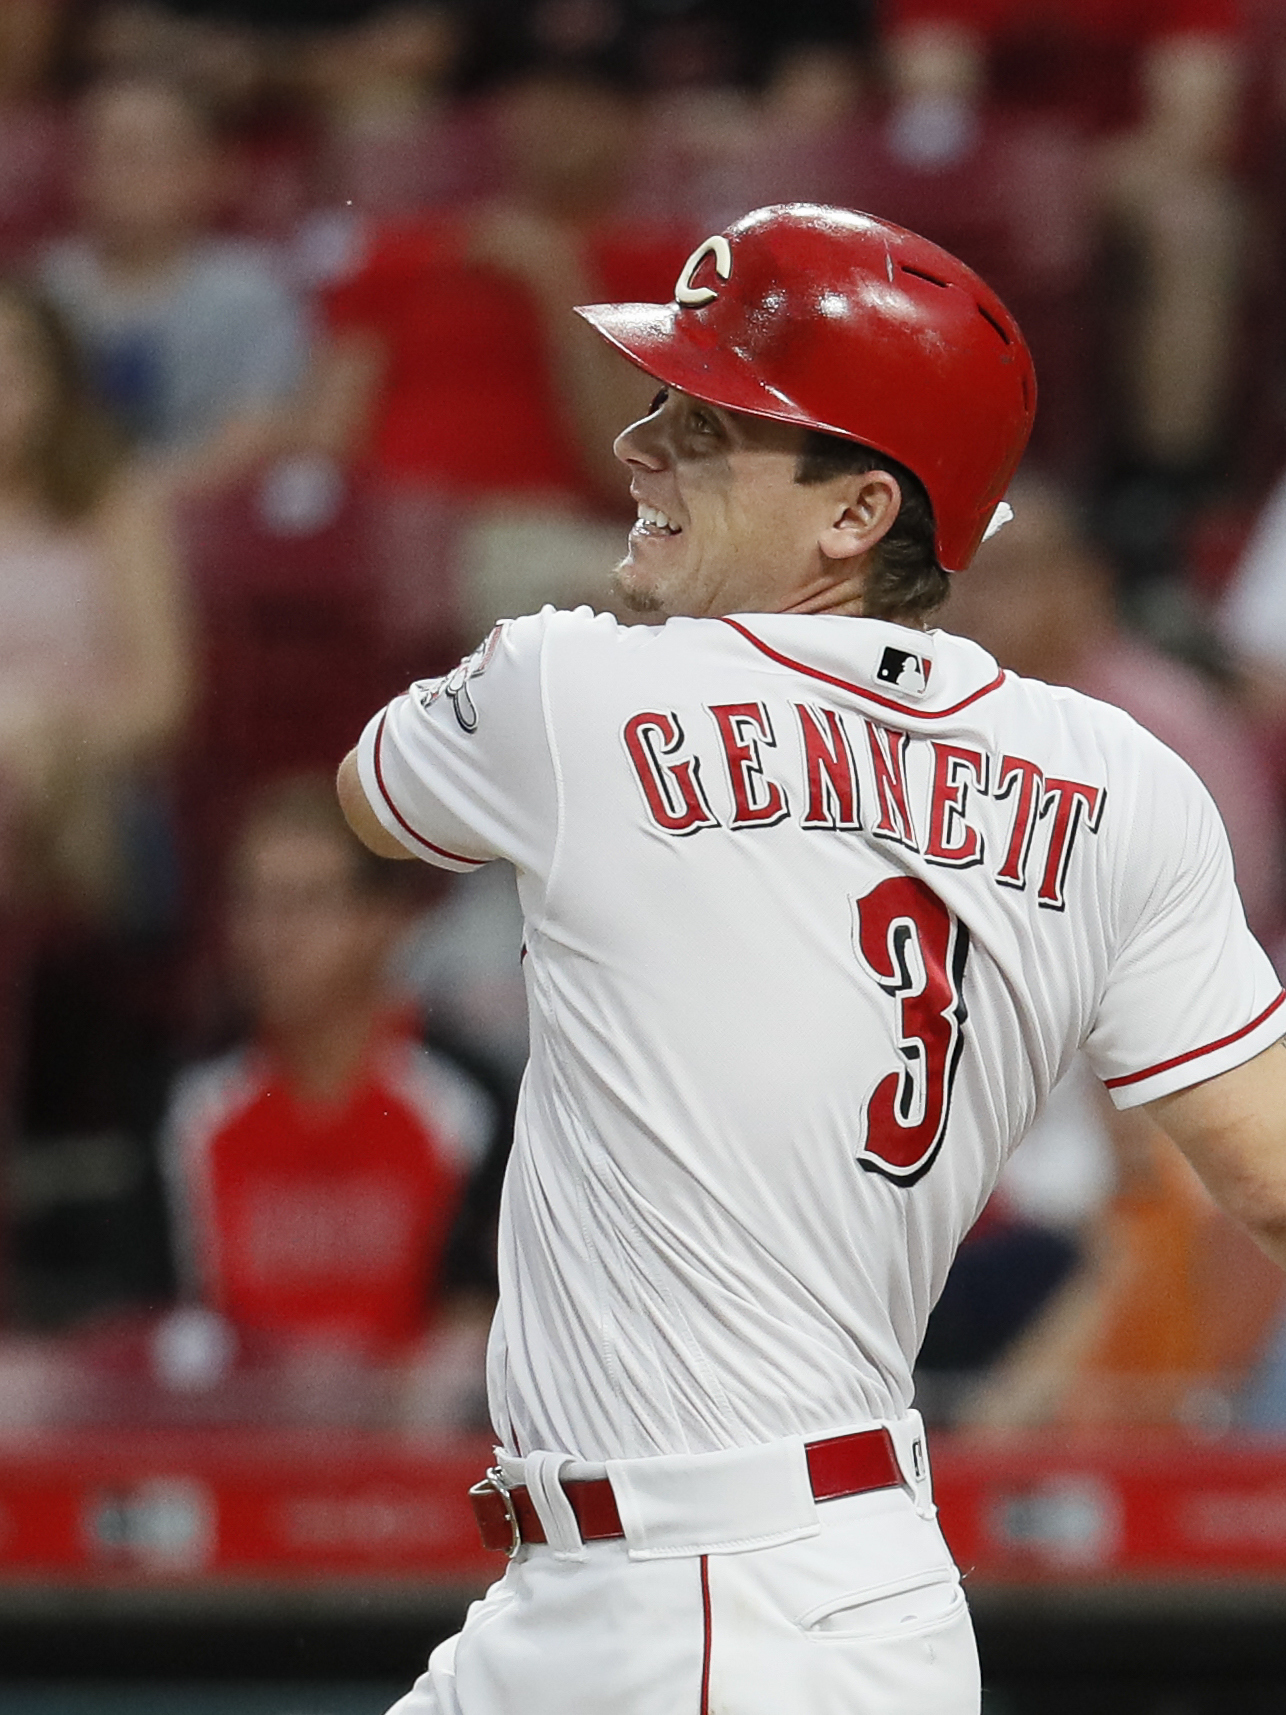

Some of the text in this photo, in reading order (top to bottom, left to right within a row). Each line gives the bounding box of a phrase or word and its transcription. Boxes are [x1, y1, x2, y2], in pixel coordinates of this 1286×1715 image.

[675, 234, 732, 308] C
[619, 698, 1106, 912] GENNETT
[848, 875, 969, 1188] 3
